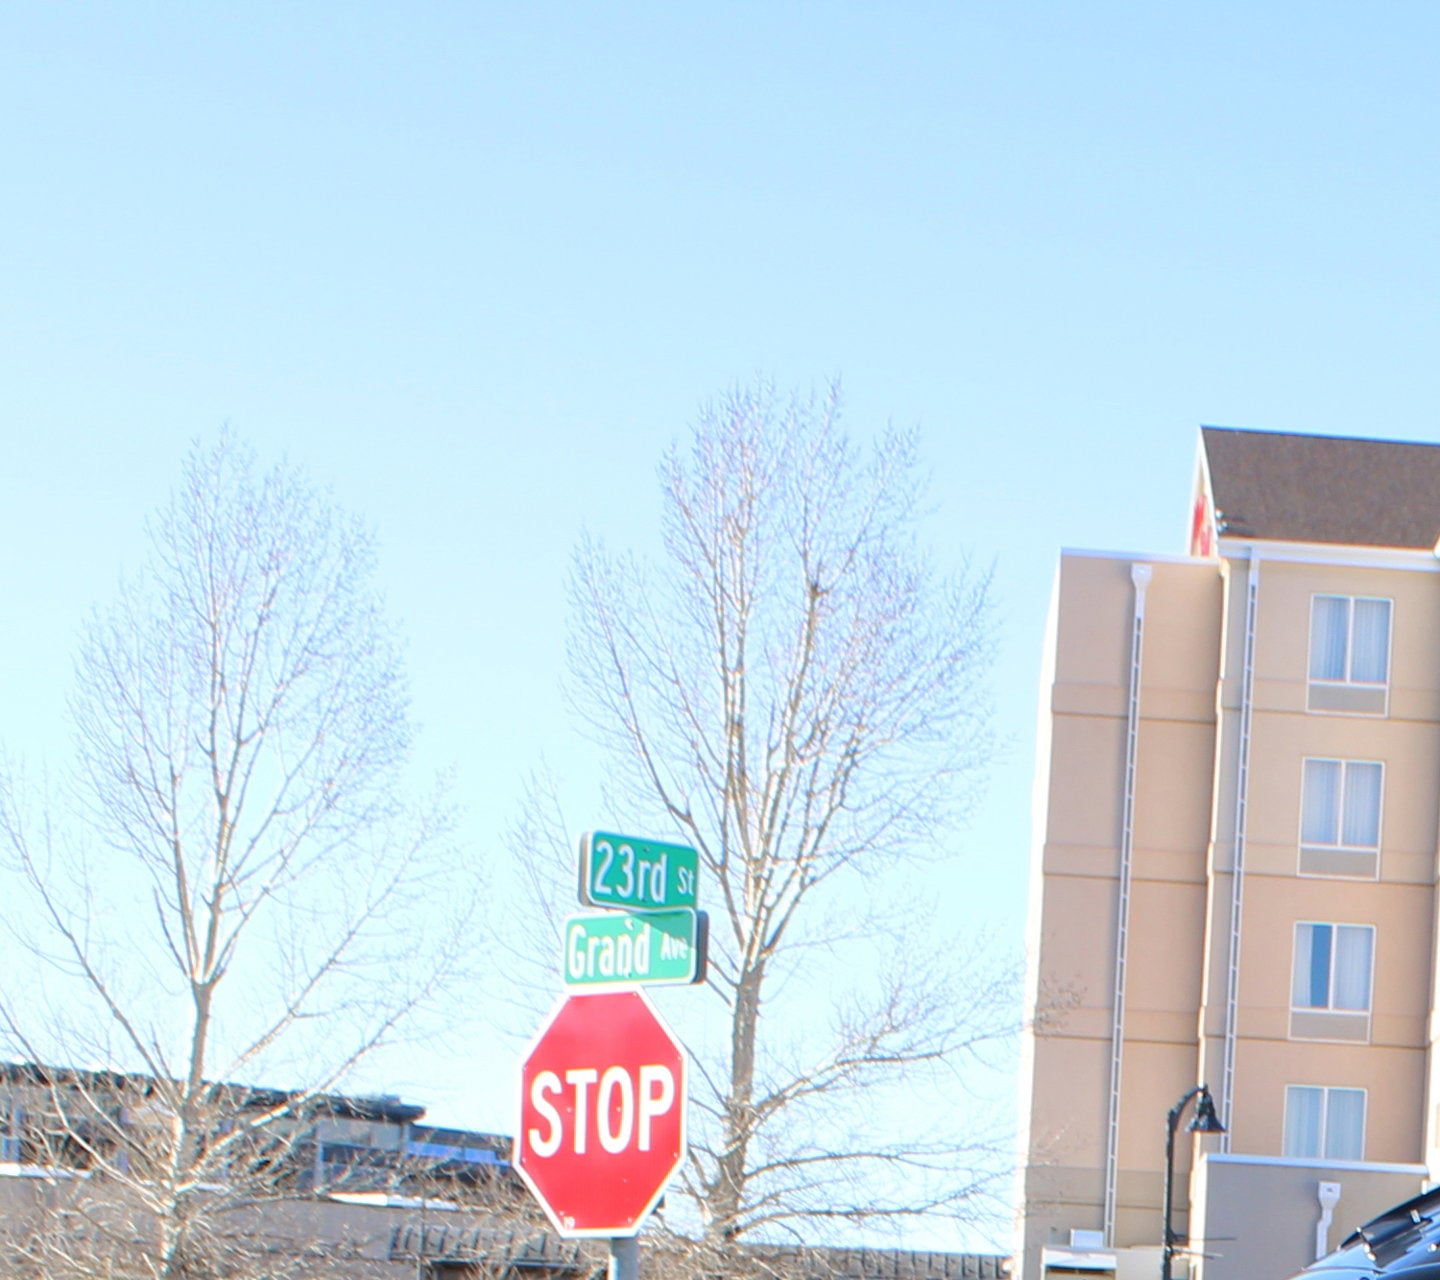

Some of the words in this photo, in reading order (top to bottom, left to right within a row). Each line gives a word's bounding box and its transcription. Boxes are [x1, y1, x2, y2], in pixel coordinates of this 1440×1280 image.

[593, 838, 667, 903] 23rd
[677, 865, 694, 896] St
[568, 922, 649, 979] Grand
[661, 931, 688, 961] Ave
[529, 1064, 674, 1158] STOP
